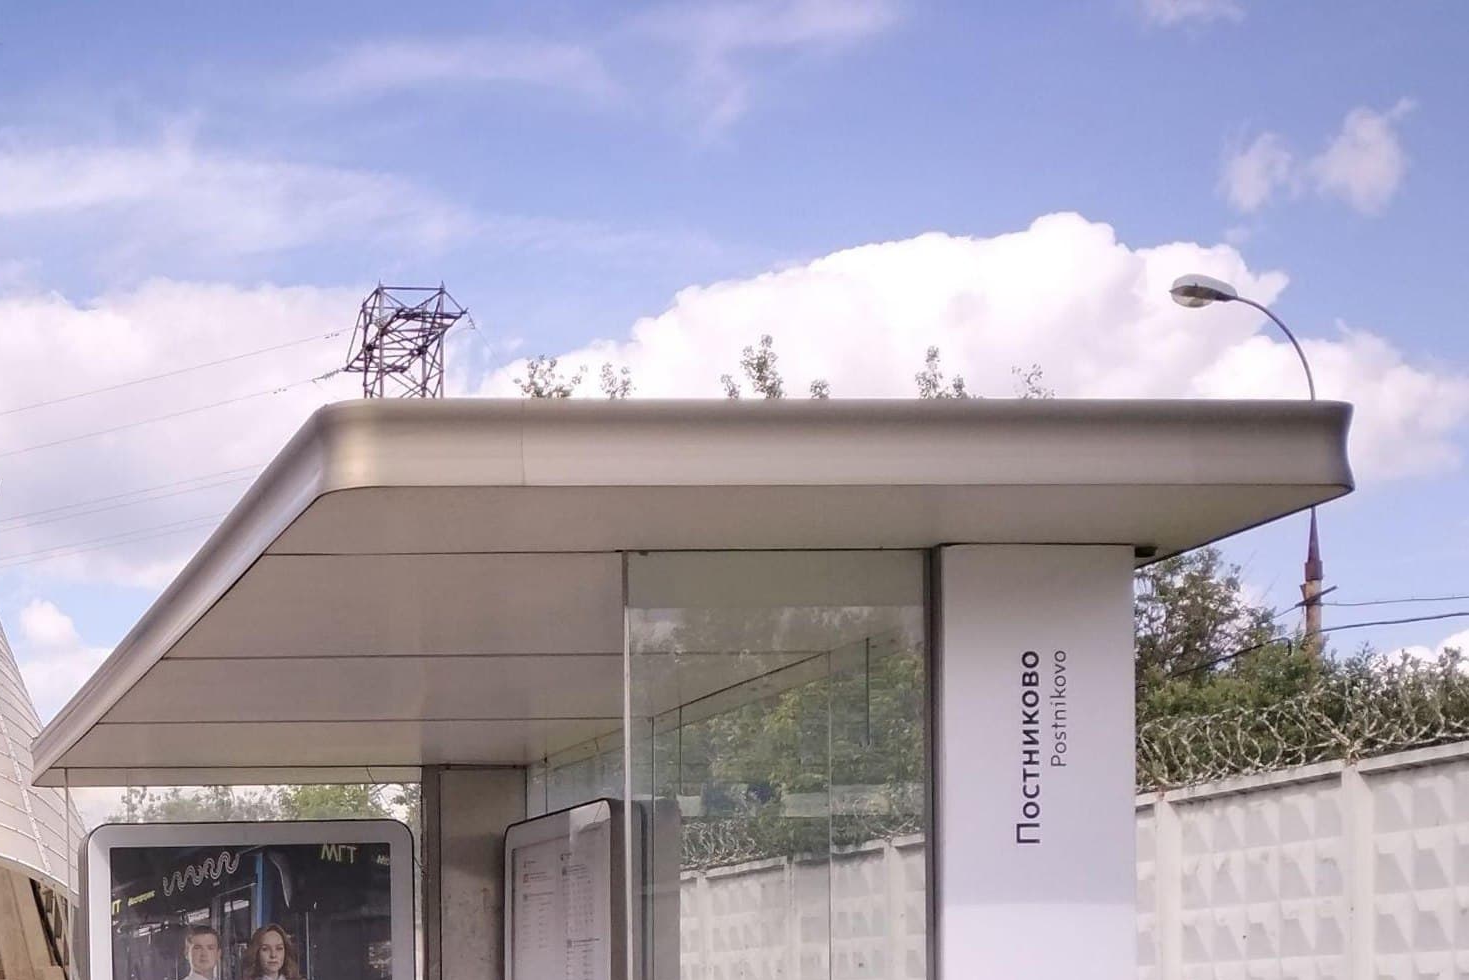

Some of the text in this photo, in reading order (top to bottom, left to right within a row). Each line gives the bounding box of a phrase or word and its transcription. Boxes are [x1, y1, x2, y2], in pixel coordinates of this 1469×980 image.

[1016, 650, 1041, 844] Постниково
[1050, 650, 1067, 767] Postnikovo
[321, 843, 357, 864] МГТ
